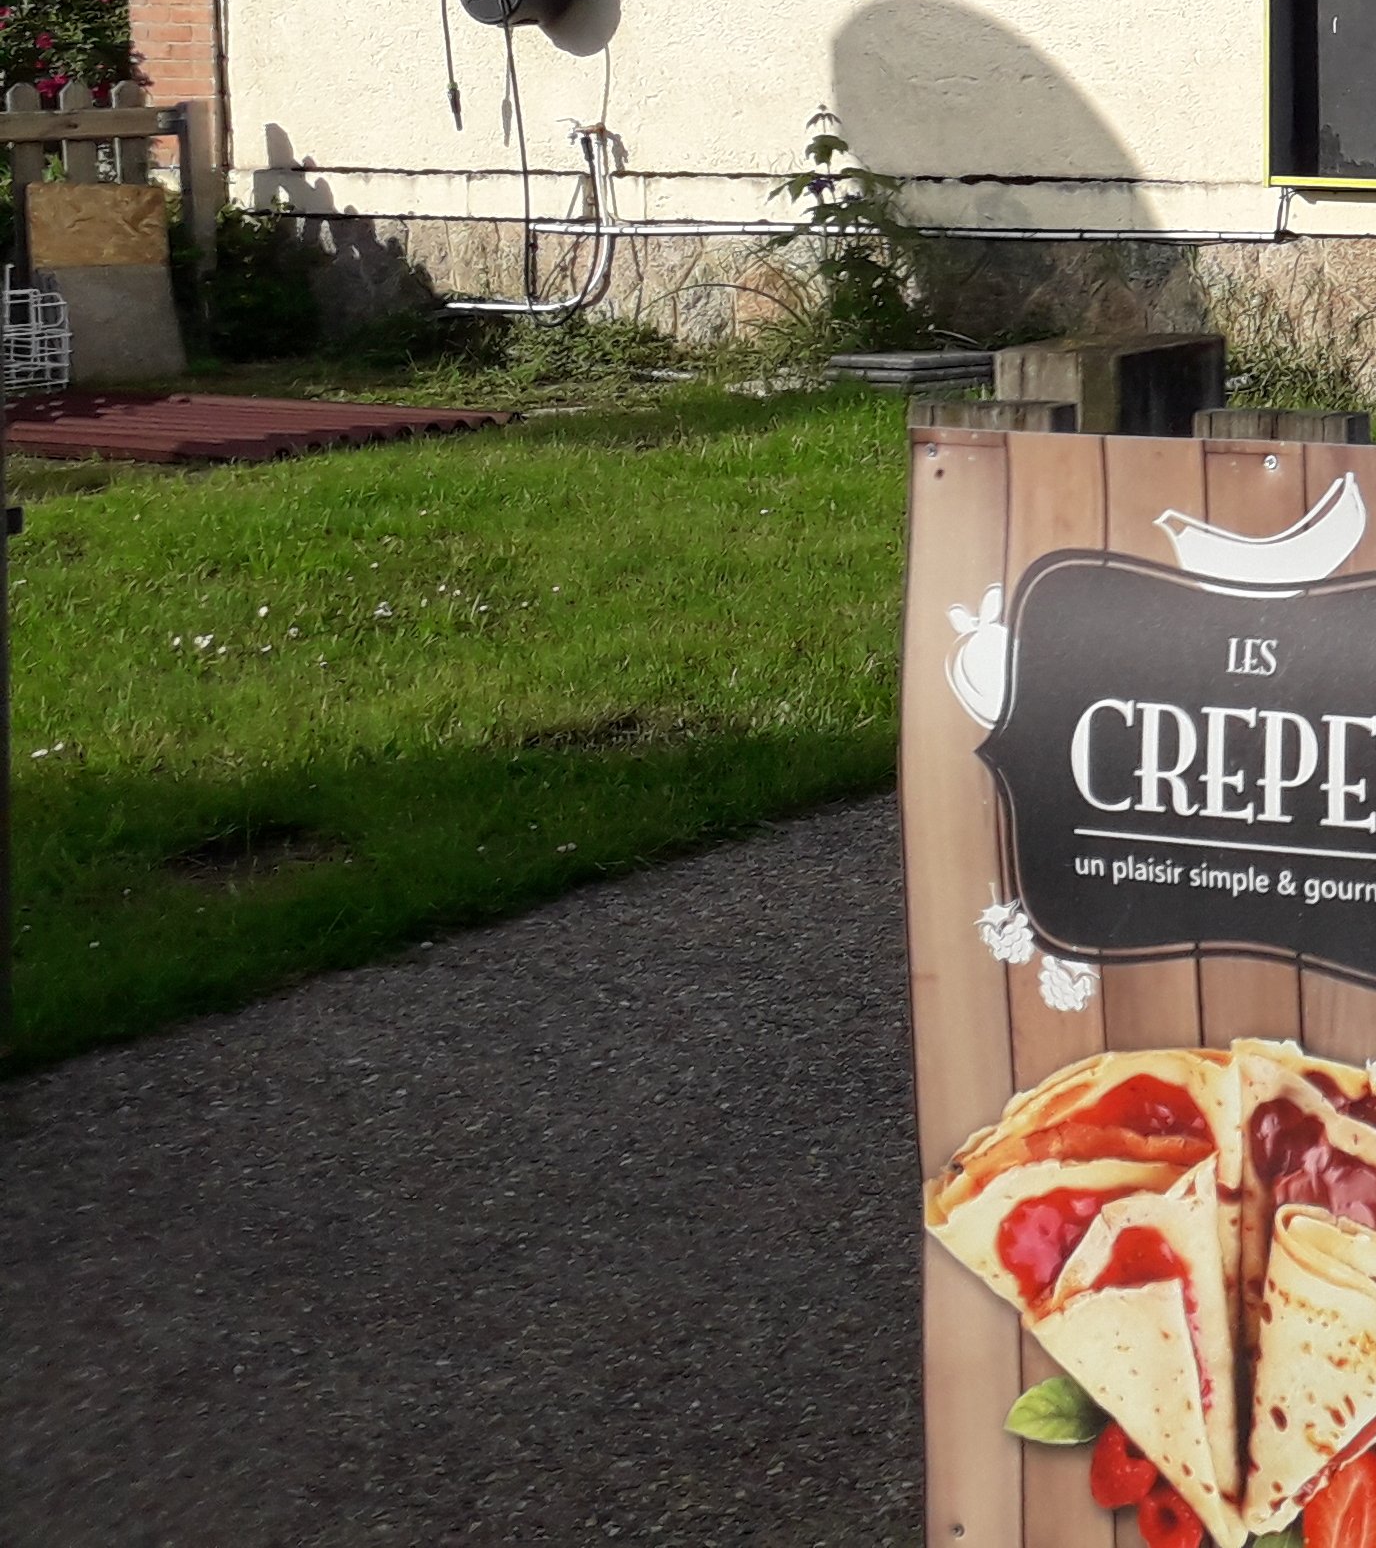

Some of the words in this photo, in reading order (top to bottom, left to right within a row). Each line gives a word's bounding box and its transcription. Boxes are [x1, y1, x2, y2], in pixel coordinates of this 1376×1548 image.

[1224, 636, 1278, 677] LES
[1074, 856, 1105, 877] un
[1112, 854, 1185, 885] plaisir
[1189, 862, 1271, 897] simple
[1276, 869, 1297, 896] &
